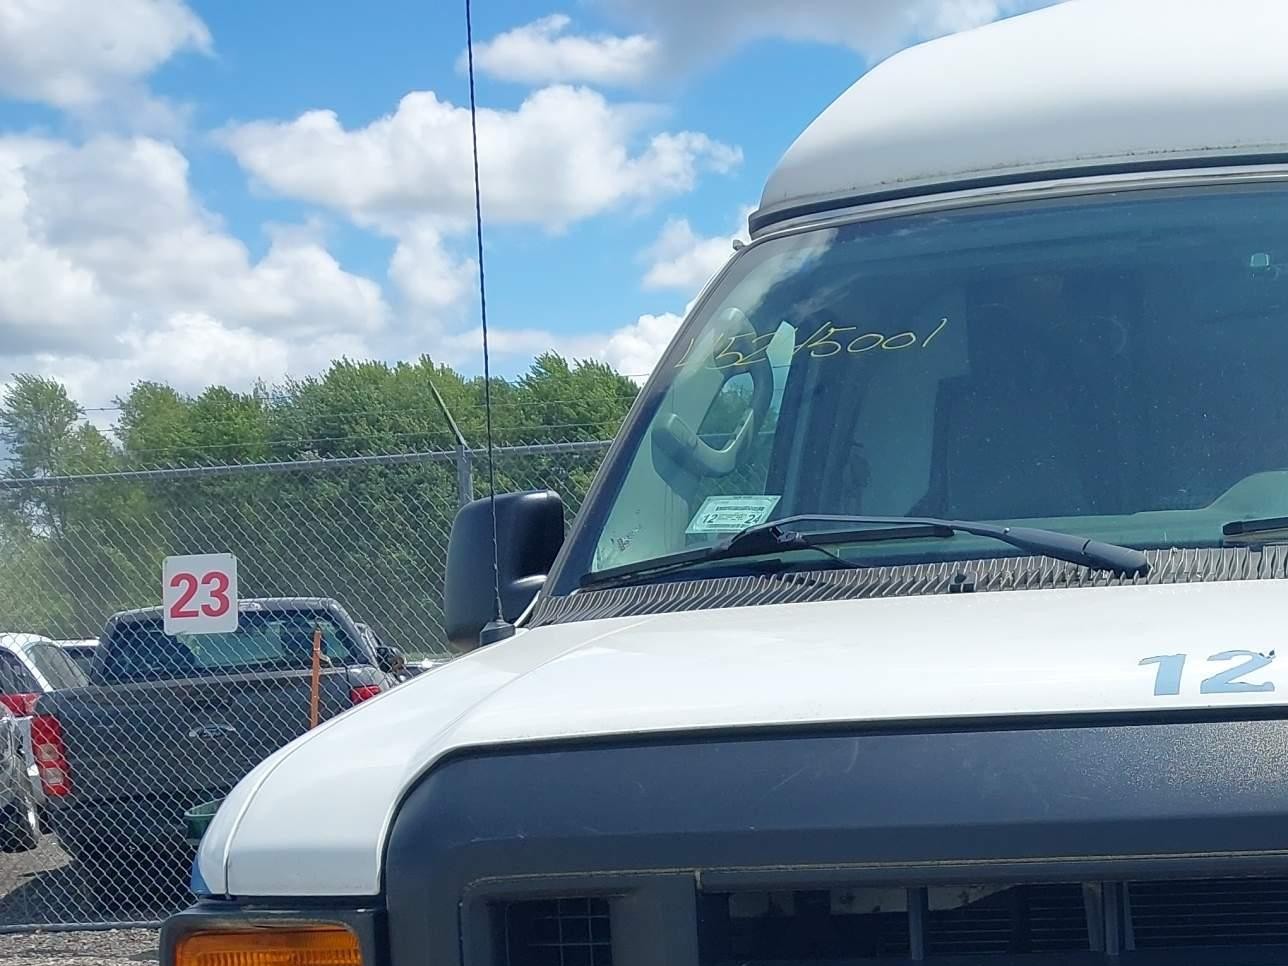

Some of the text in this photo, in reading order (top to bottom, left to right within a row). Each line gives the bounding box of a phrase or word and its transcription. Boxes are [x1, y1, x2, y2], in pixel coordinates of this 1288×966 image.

[703, 513, 718, 524] 12
[170, 571, 230, 618] 23
[1138, 649, 1276, 696] 12
